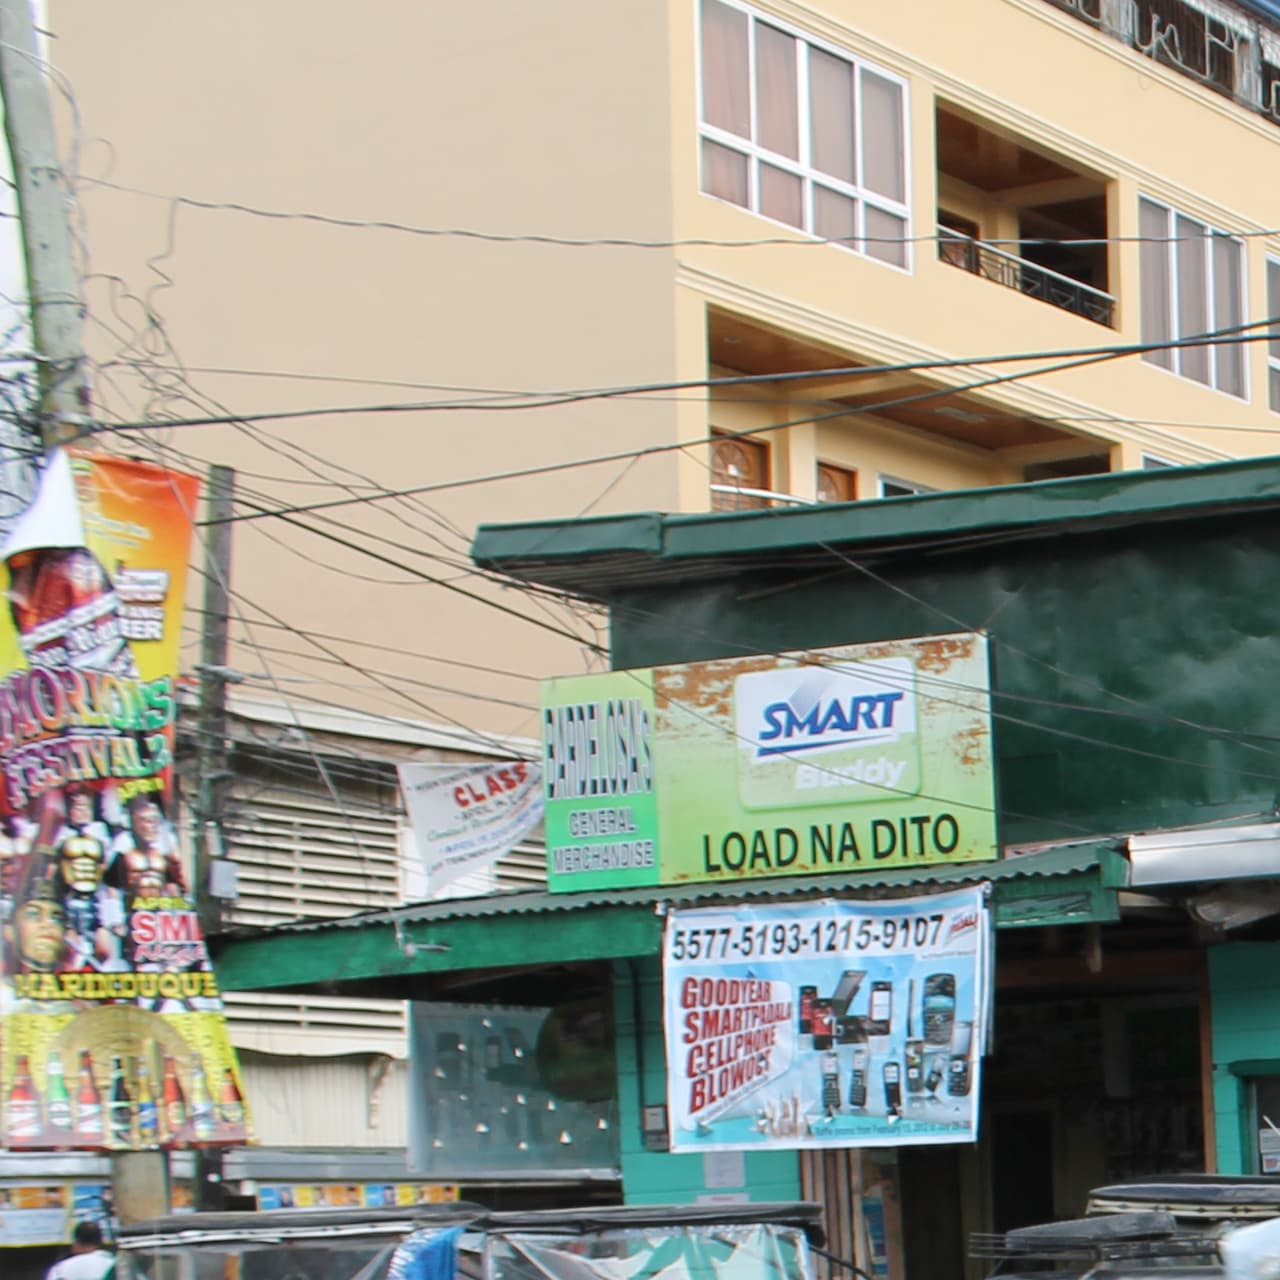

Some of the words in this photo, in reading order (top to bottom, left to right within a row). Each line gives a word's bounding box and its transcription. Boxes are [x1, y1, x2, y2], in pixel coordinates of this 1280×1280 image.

[758, 691, 904, 741] SMART
[453, 762, 530, 808] CLASS
[795, 757, 908, 790] Buddy
[568, 806, 637, 838] GENERAL
[703, 827, 799, 873] LOAD
[809, 822, 861, 865] NA
[871, 813, 960, 860] DITO
[552, 839, 655, 875] MERCHANDISE
[672, 914, 943, 961] 5577-5193-1215-9107
[681, 976, 772, 1009] GOODYEAR
[682, 1001, 793, 1045] SMARTPADALA
[686, 1026, 777, 1079] CELLPHONE
